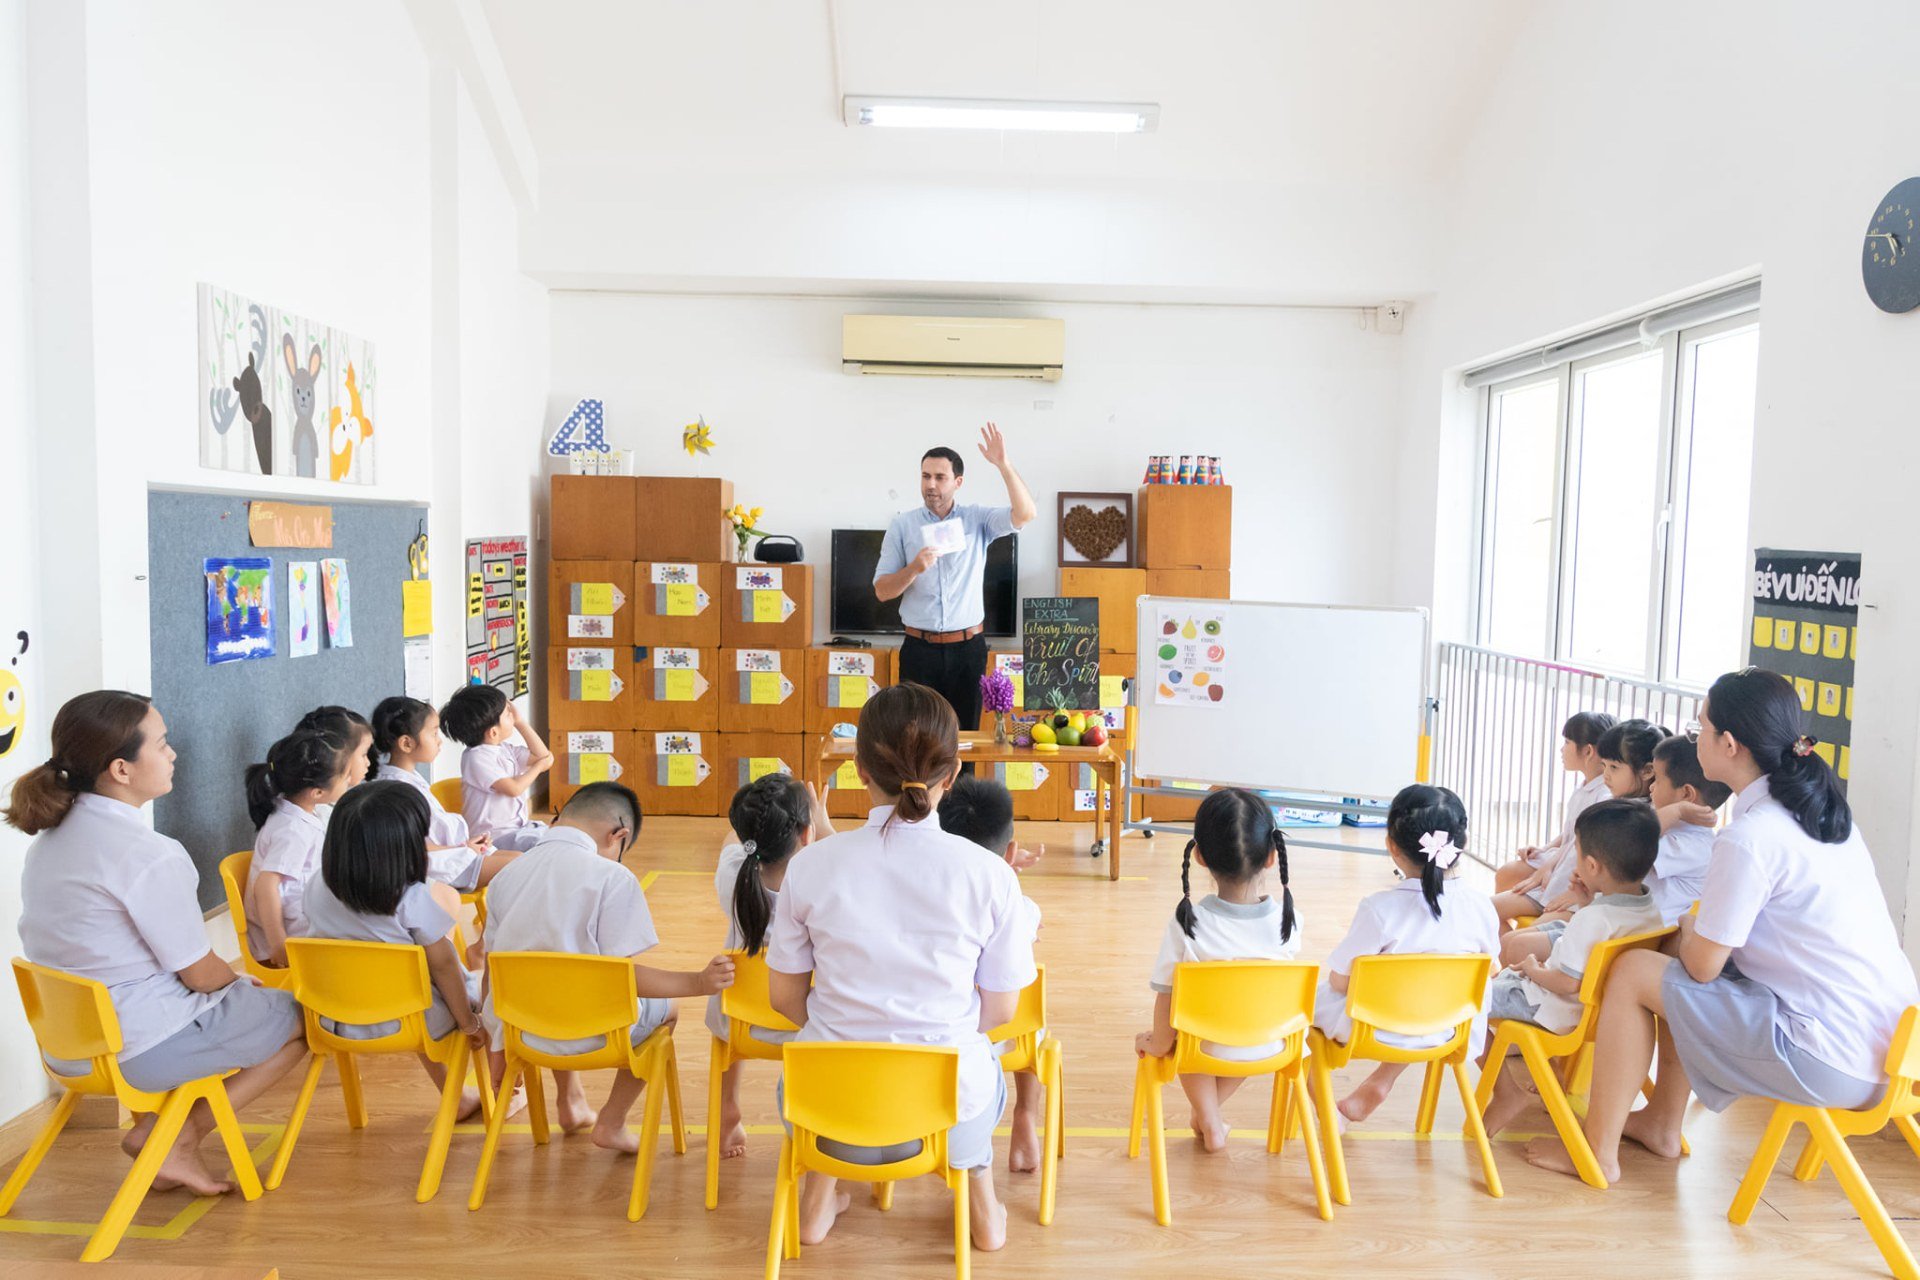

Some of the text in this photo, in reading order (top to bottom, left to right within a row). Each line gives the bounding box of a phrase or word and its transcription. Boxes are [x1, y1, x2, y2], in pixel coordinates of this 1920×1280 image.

[549, 398, 611, 455] 4
[1024, 598, 1073, 609] ENGLISH
[1034, 609, 1069, 619] EXTRA
